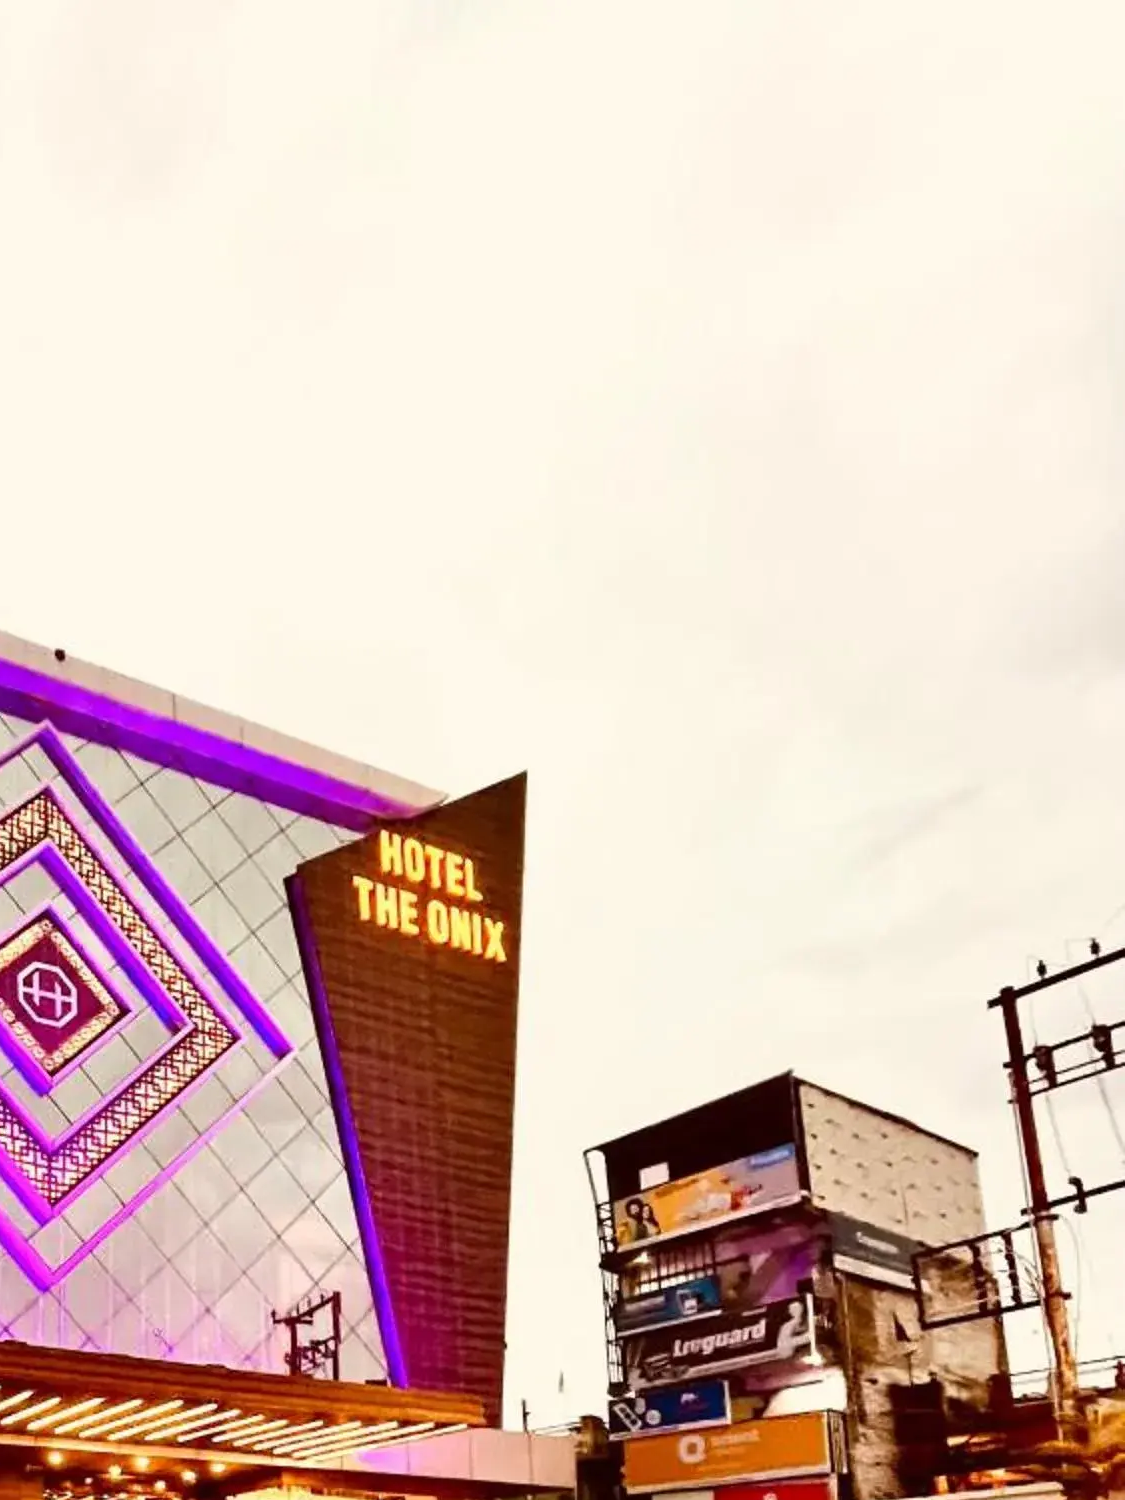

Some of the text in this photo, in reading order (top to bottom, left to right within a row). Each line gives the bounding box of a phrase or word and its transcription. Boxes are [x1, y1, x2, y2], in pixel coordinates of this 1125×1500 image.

[379, 829, 483, 902] HOTEL
[352, 874, 507, 963] THE ONIX
